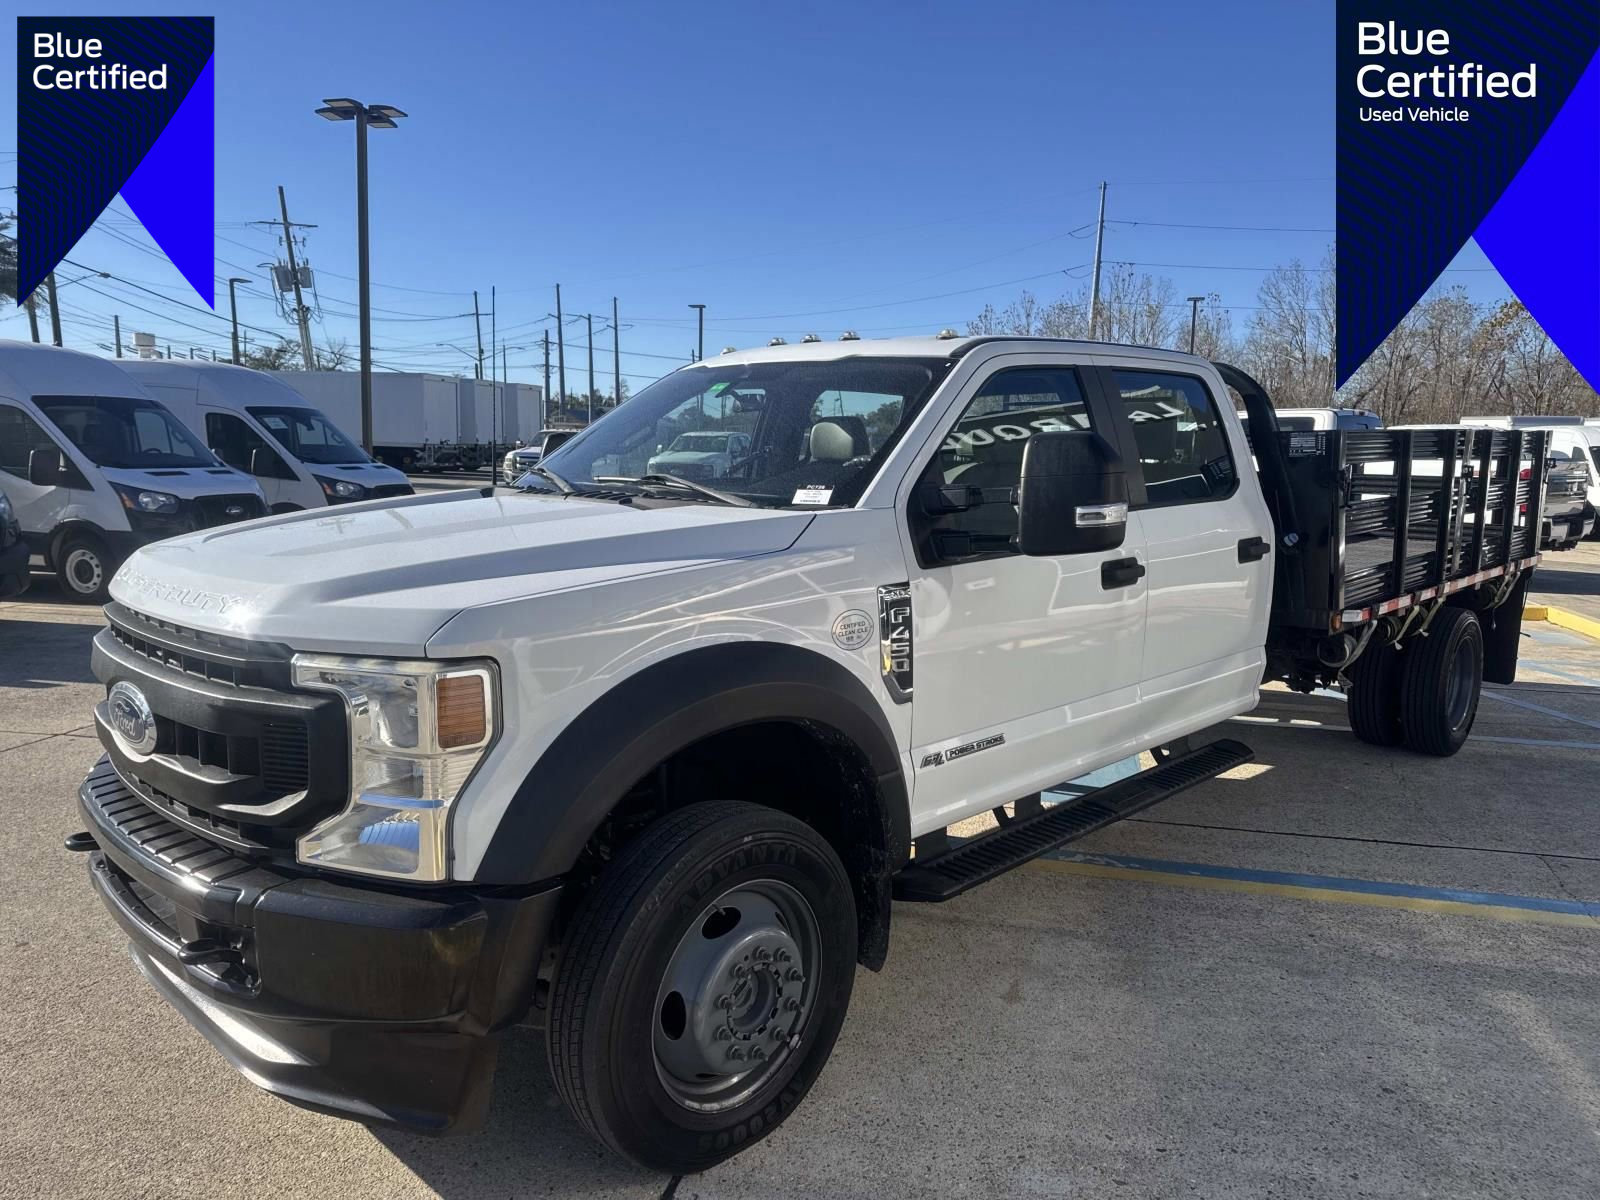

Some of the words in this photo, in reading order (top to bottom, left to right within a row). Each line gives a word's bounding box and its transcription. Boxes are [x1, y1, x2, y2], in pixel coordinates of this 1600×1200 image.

[840, 620, 867, 631] CERTIFIED
[837, 628, 857, 638] CLEAN
[976, 734, 1005, 750] STROKE
